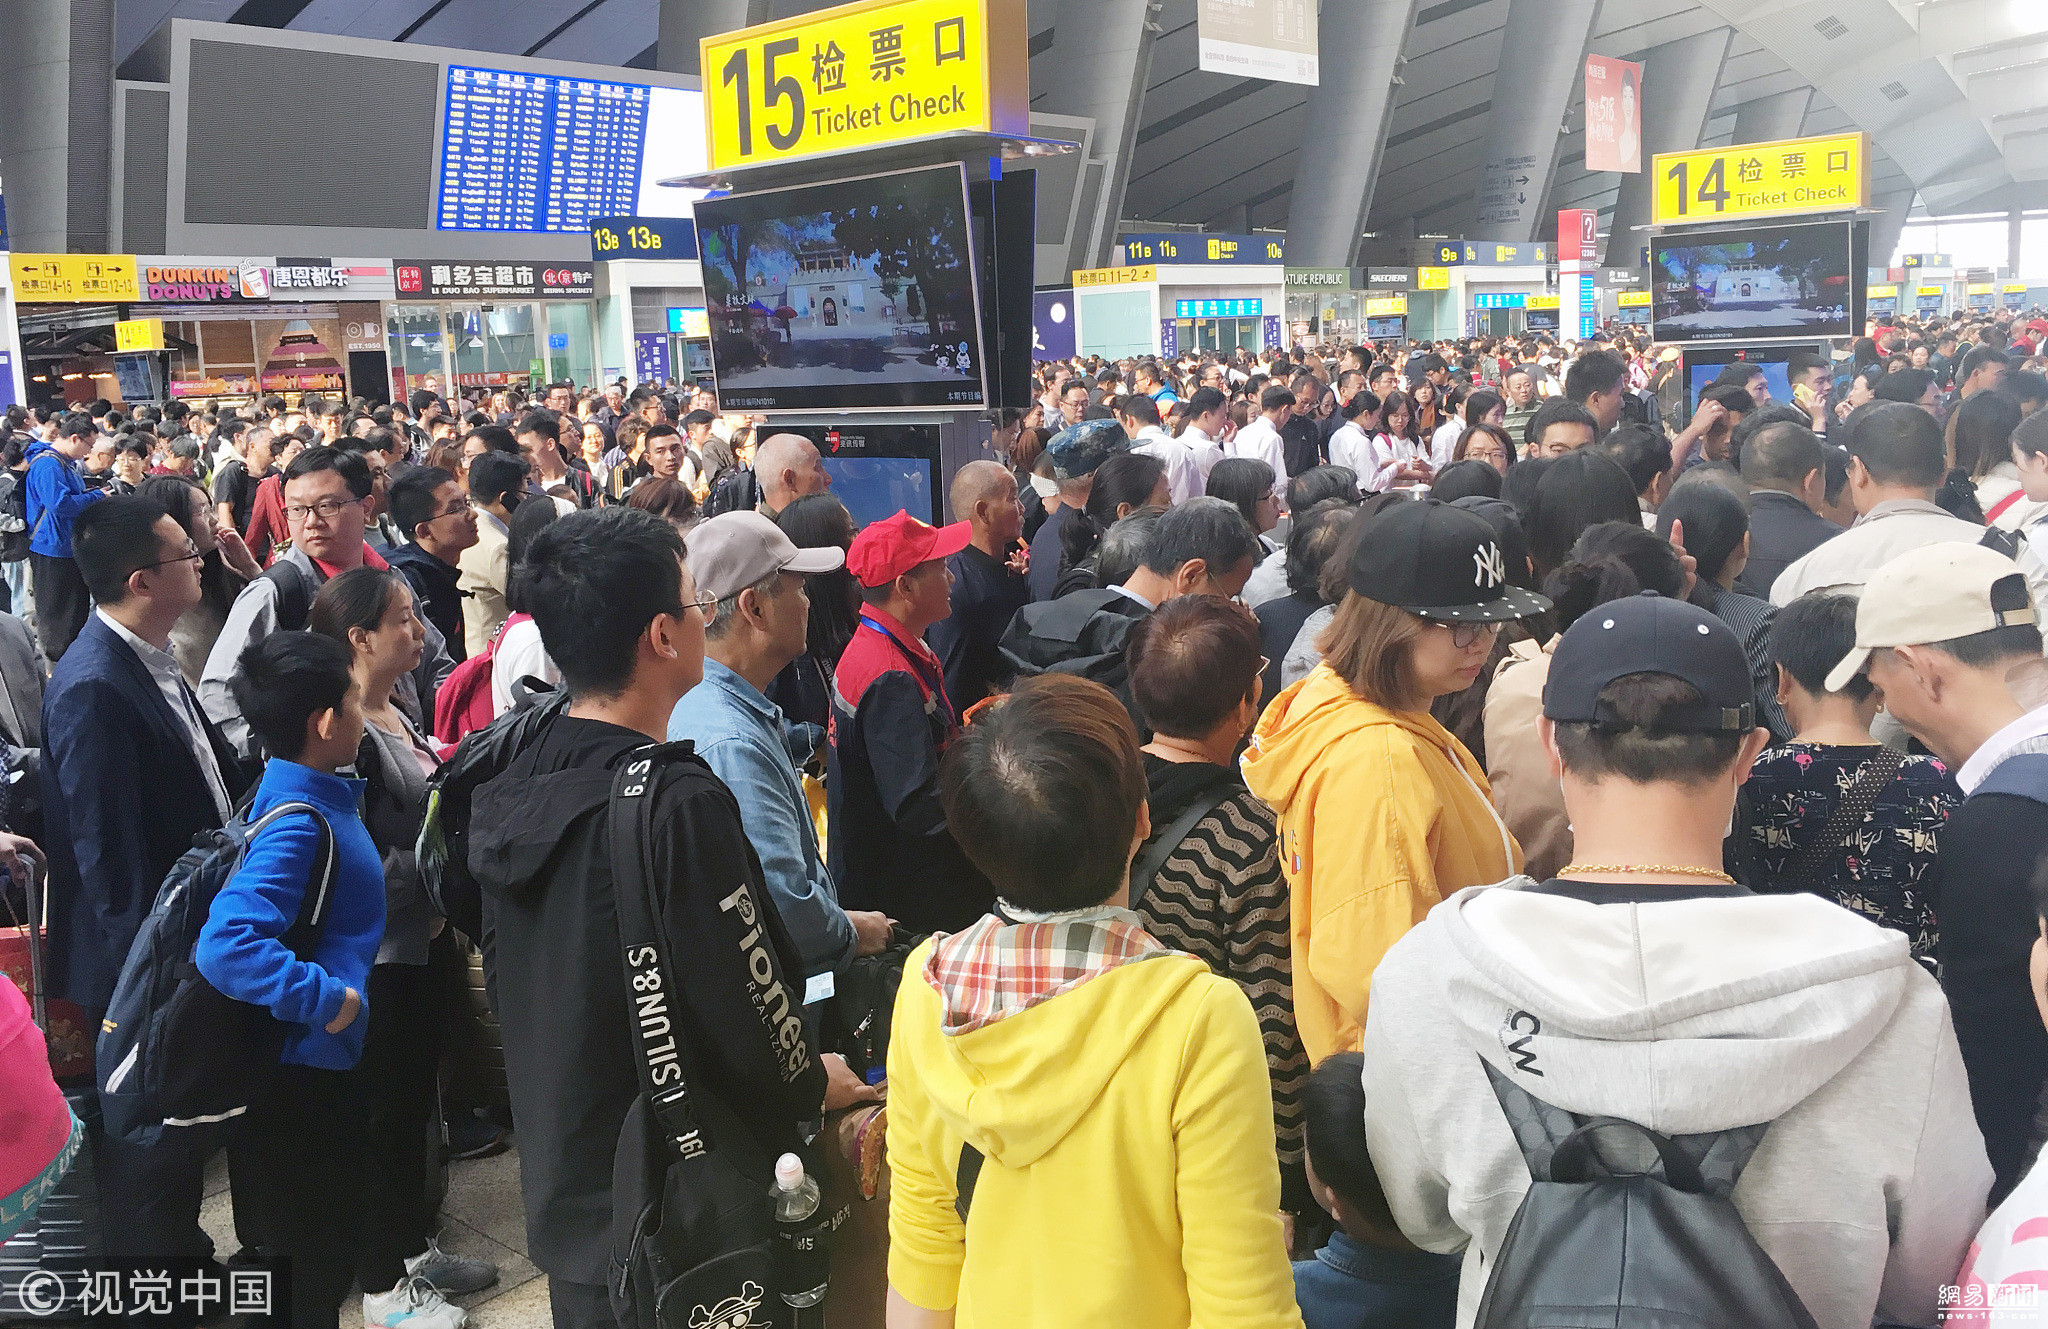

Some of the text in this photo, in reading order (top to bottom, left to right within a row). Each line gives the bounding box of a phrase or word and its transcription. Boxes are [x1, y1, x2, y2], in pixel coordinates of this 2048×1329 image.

[811, 16, 966, 96] 检票口
[723, 37, 805, 157] 15
[811, 84, 966, 136] Ticket Check
[1737, 150, 1848, 183] 检票口
[1668, 157, 1731, 215] 14
[1736, 184, 1847, 207] Ticket Check
[594, 226, 662, 251] 13B 13B
[1128, 240, 1177, 259] 11B 11B
[1266, 242, 1282, 259] 10B
[1440, 246, 1476, 262] 9B 9B
[1535, 247, 1545, 261] 8B
[1905, 256, 1918, 266] 3B
[272, 266, 349, 288] 唐恩都乐
[430, 265, 534, 286] 利多宝超市
[1079, 268, 1138, 284] 检票口 11-2
[1309, 273, 1343, 285] REPUBLIC
[1369, 274, 1408, 283] SKECHERS
[431, 287, 535, 295] LI DUO BAO SUPERMARKET
[1623, 294, 1630, 304] 8
[1531, 297, 1538, 307] 9
[119, 326, 131, 349] 14
[718, 882, 811, 1084] Pioneer
[1507, 1010, 1544, 1077] CW
